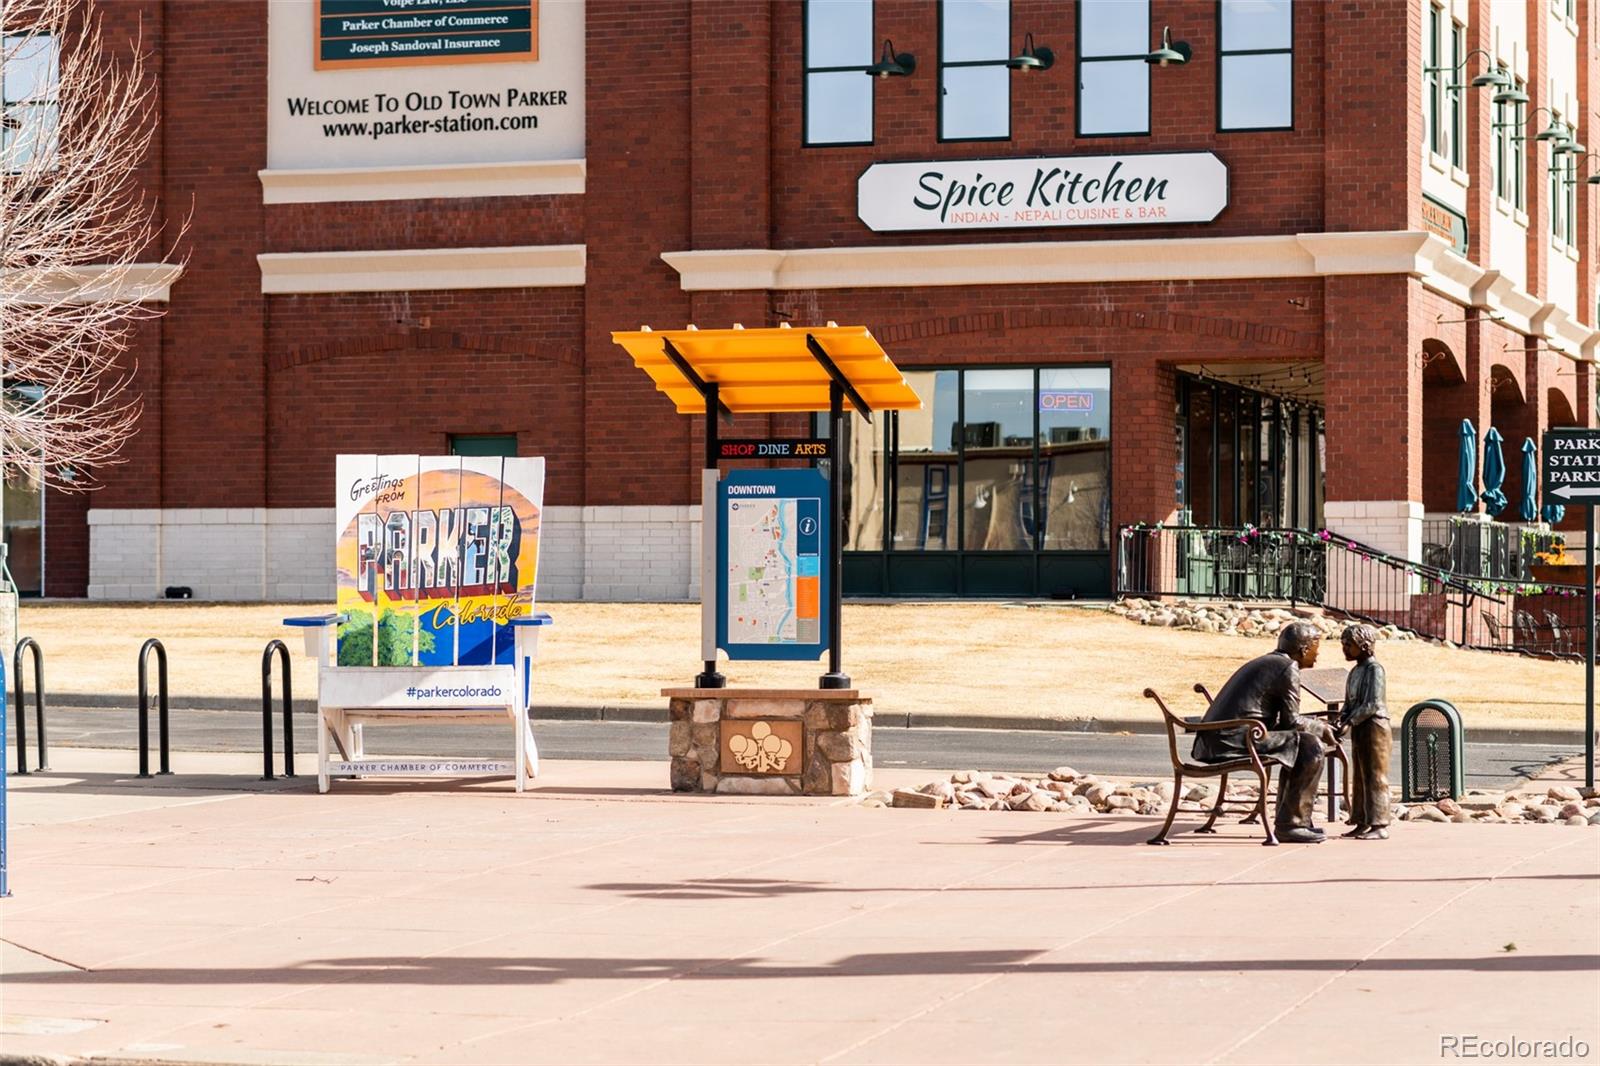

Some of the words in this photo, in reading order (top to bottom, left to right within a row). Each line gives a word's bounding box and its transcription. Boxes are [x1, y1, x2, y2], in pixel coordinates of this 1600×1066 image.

[342, 20, 380, 31] Parker
[381, 18, 433, 29] Chamber
[434, 16, 447, 27] of
[448, 15, 508, 26] Commerce
[350, 41, 389, 54] Joseph
[391, 39, 442, 51] Sandoval
[444, 38, 500, 49] Insurance
[323, 113, 538, 139] www.parker-station.com
[913, 171, 1014, 223] Spice
[1026, 161, 1169, 208] Kitchen
[951, 212, 1000, 224] INDIAN
[1014, 209, 1063, 222] NEPALI
[1066, 207, 1120, 220] CUISINE
[1124, 207, 1133, 219] &
[1139, 206, 1167, 218] BAR
[1042, 394, 1090, 409] OPEN
[721, 444, 755, 455] SHOP
[758, 443, 790, 455] DINE
[794, 443, 827, 455] ARTS
[1554, 439, 1600, 450] PARK
[350, 474, 405, 501] Greetings
[728, 485, 776, 495] DOWNTOWN
[375, 490, 406, 504] FROM
[357, 505, 521, 602] PARKER
[432, 595, 522, 630] Colorado
[406, 685, 502, 700] #parkercolorado
[341, 764, 376, 772] PARKER
[380, 764, 426, 772] CHAMBER
[430, 764, 441, 772] OF
[445, 763, 499, 772] COMMERCE
